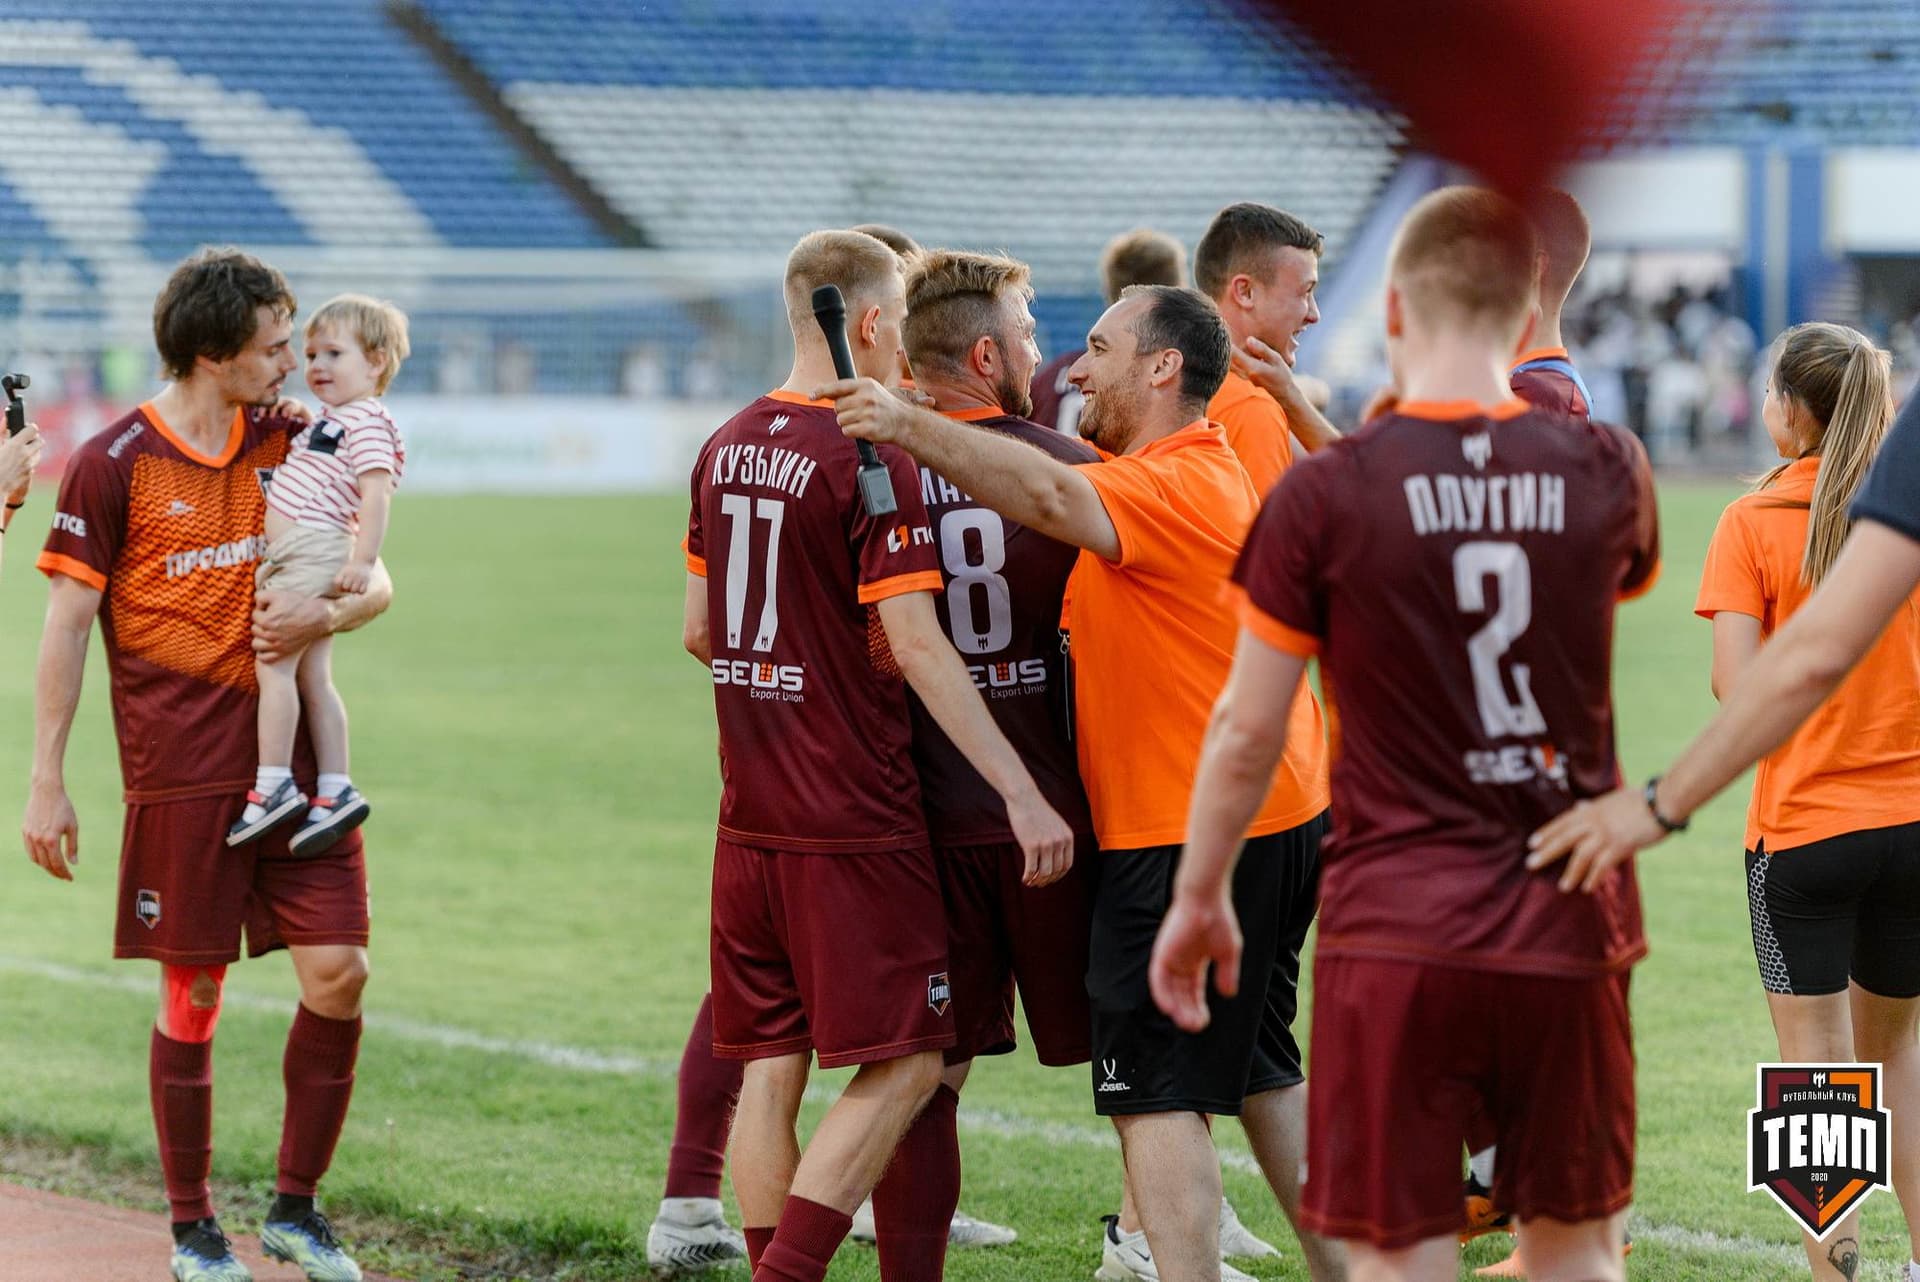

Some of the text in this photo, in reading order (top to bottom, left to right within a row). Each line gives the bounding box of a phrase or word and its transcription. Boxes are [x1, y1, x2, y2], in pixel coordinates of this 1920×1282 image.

[711, 444, 817, 499] КУЗЬКИН
[1404, 472, 1565, 536] ПЛУГИН
[721, 493, 785, 652] 17
[940, 508, 1012, 654] 8
[1452, 541, 1549, 738] 2
[712, 658, 804, 691] SEUS
[750, 687, 782, 701] Export
[967, 658, 1047, 689] EUS
[991, 687, 1022, 699] Export
